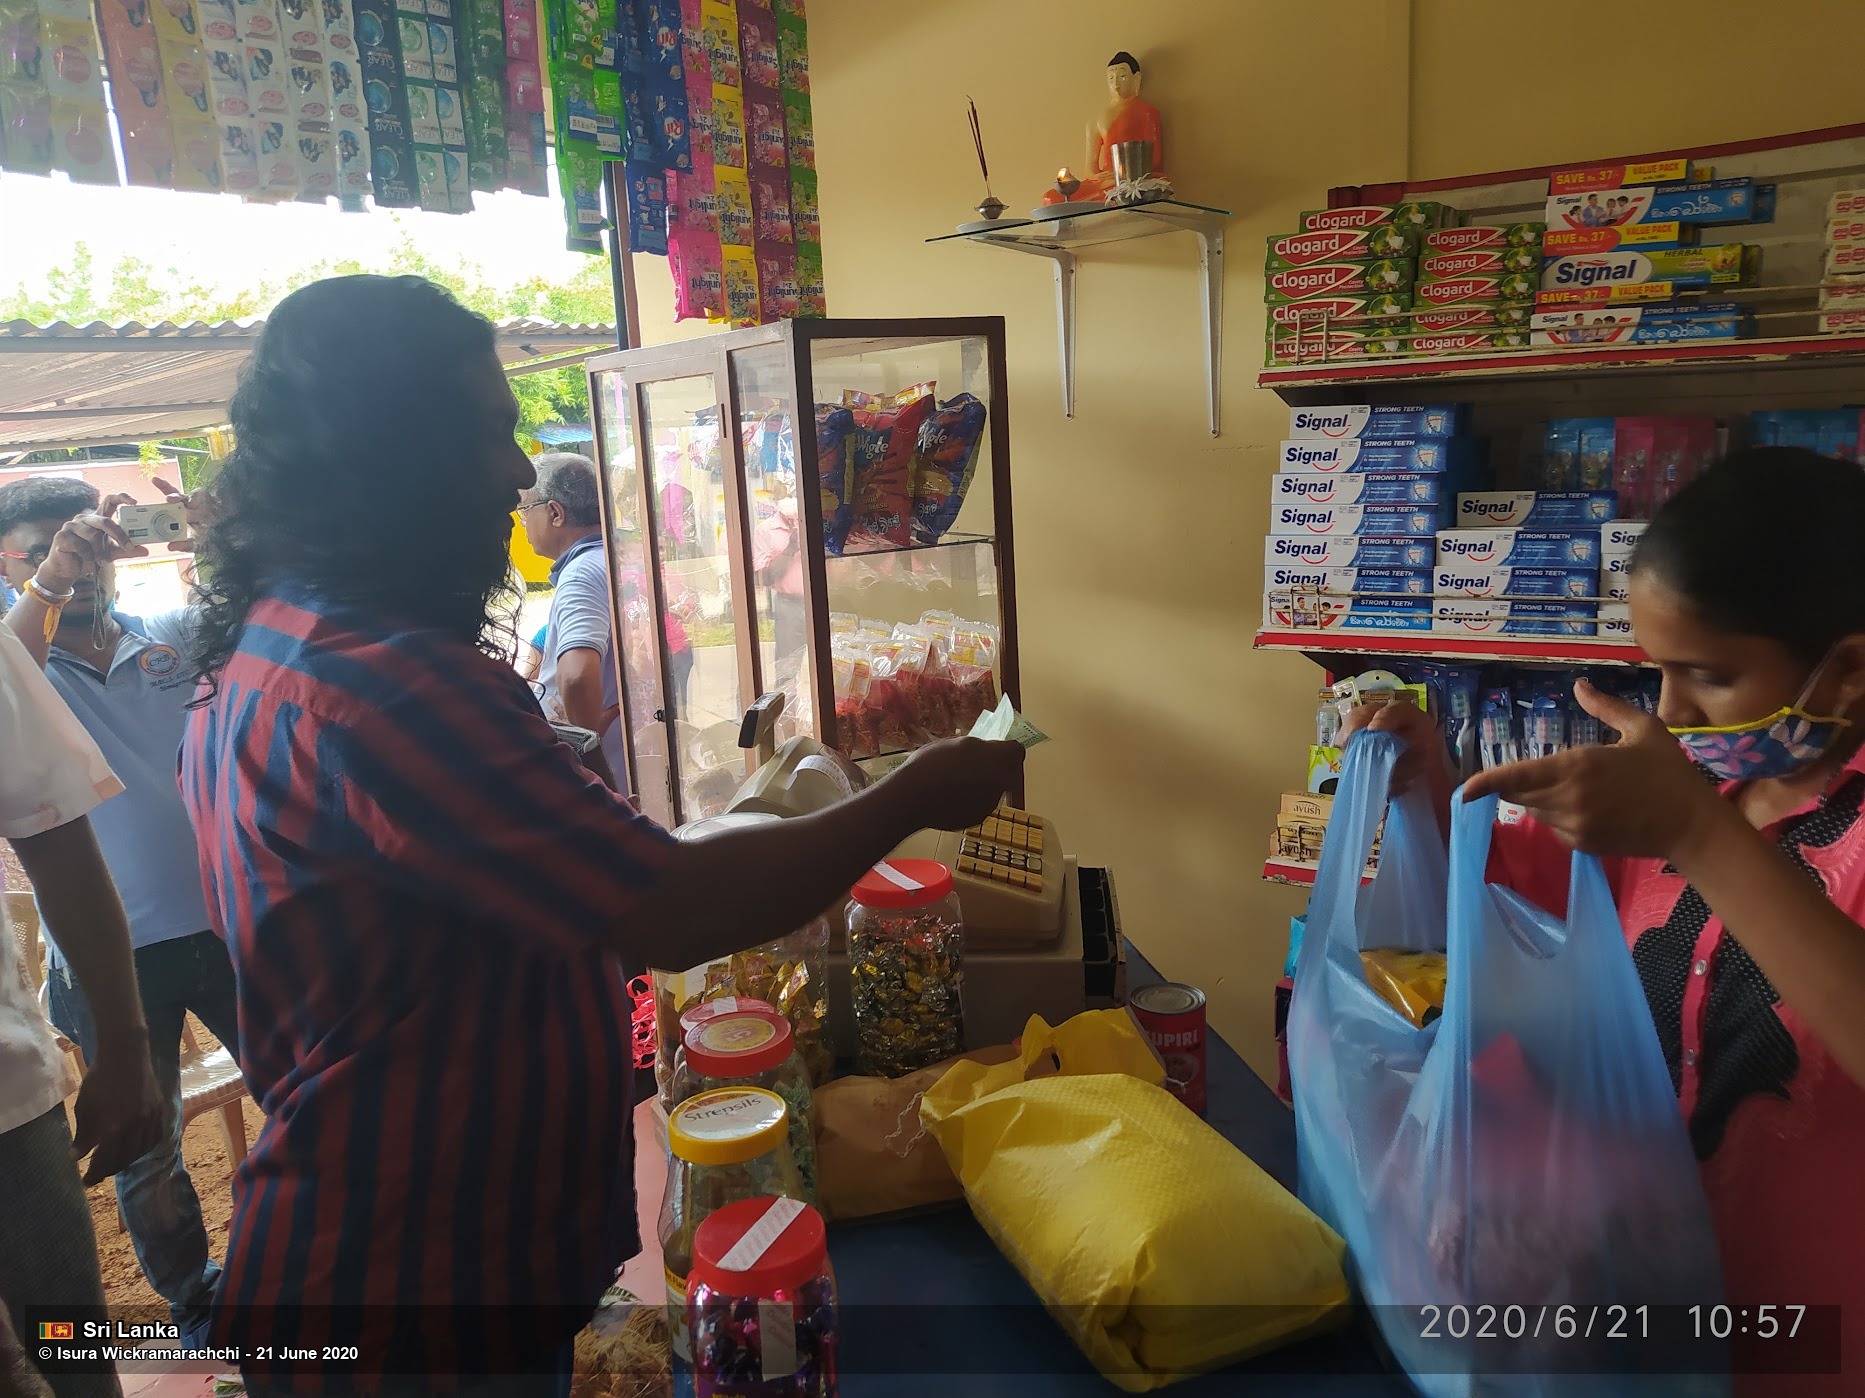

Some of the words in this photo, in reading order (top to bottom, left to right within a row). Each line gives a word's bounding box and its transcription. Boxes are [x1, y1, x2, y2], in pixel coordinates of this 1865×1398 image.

[1556, 170, 1584, 185] SAVE
[1632, 163, 1656, 176] VALUE
[1658, 162, 1680, 173] PACK
[1556, 196, 1582, 206] Signal
[1305, 210, 1367, 231] Clogard
[1274, 234, 1339, 257] Clogard
[1427, 231, 1480, 247] Clogard
[1547, 233, 1576, 246] SAVE
[1664, 248, 1704, 258] HERBAL
[1424, 255, 1478, 272] Clogard
[1555, 258, 1638, 286] Signal
[691, 276, 722, 291] unlight
[1271, 268, 1336, 290] Clogard
[1420, 281, 1473, 299] Clogard
[1541, 292, 1571, 305] SAVE
[1618, 284, 1644, 297] VALUE
[1645, 283, 1666, 295] PACK
[1542, 315, 1569, 325] Signal
[1413, 336, 1466, 350] Clogard
[1295, 413, 1349, 431] Signal
[1286, 447, 1339, 464] Signal
[1281, 477, 1334, 495] Signal
[1461, 499, 1514, 516] Signal
[1280, 508, 1333, 526] Signal
[1274, 539, 1328, 557] Signal
[1440, 538, 1493, 555] Signal
[1274, 569, 1327, 586] Signal
[1438, 574, 1491, 590] Signal
[1270, 595, 1291, 604] Signa
[1438, 607, 1490, 625] Signal
[1606, 617, 1633, 633] Sig
[1293, 803, 1321, 816] ayush
[1151, 1028, 1199, 1048] UPIRI
[684, 1096, 762, 1124] Strepsils
